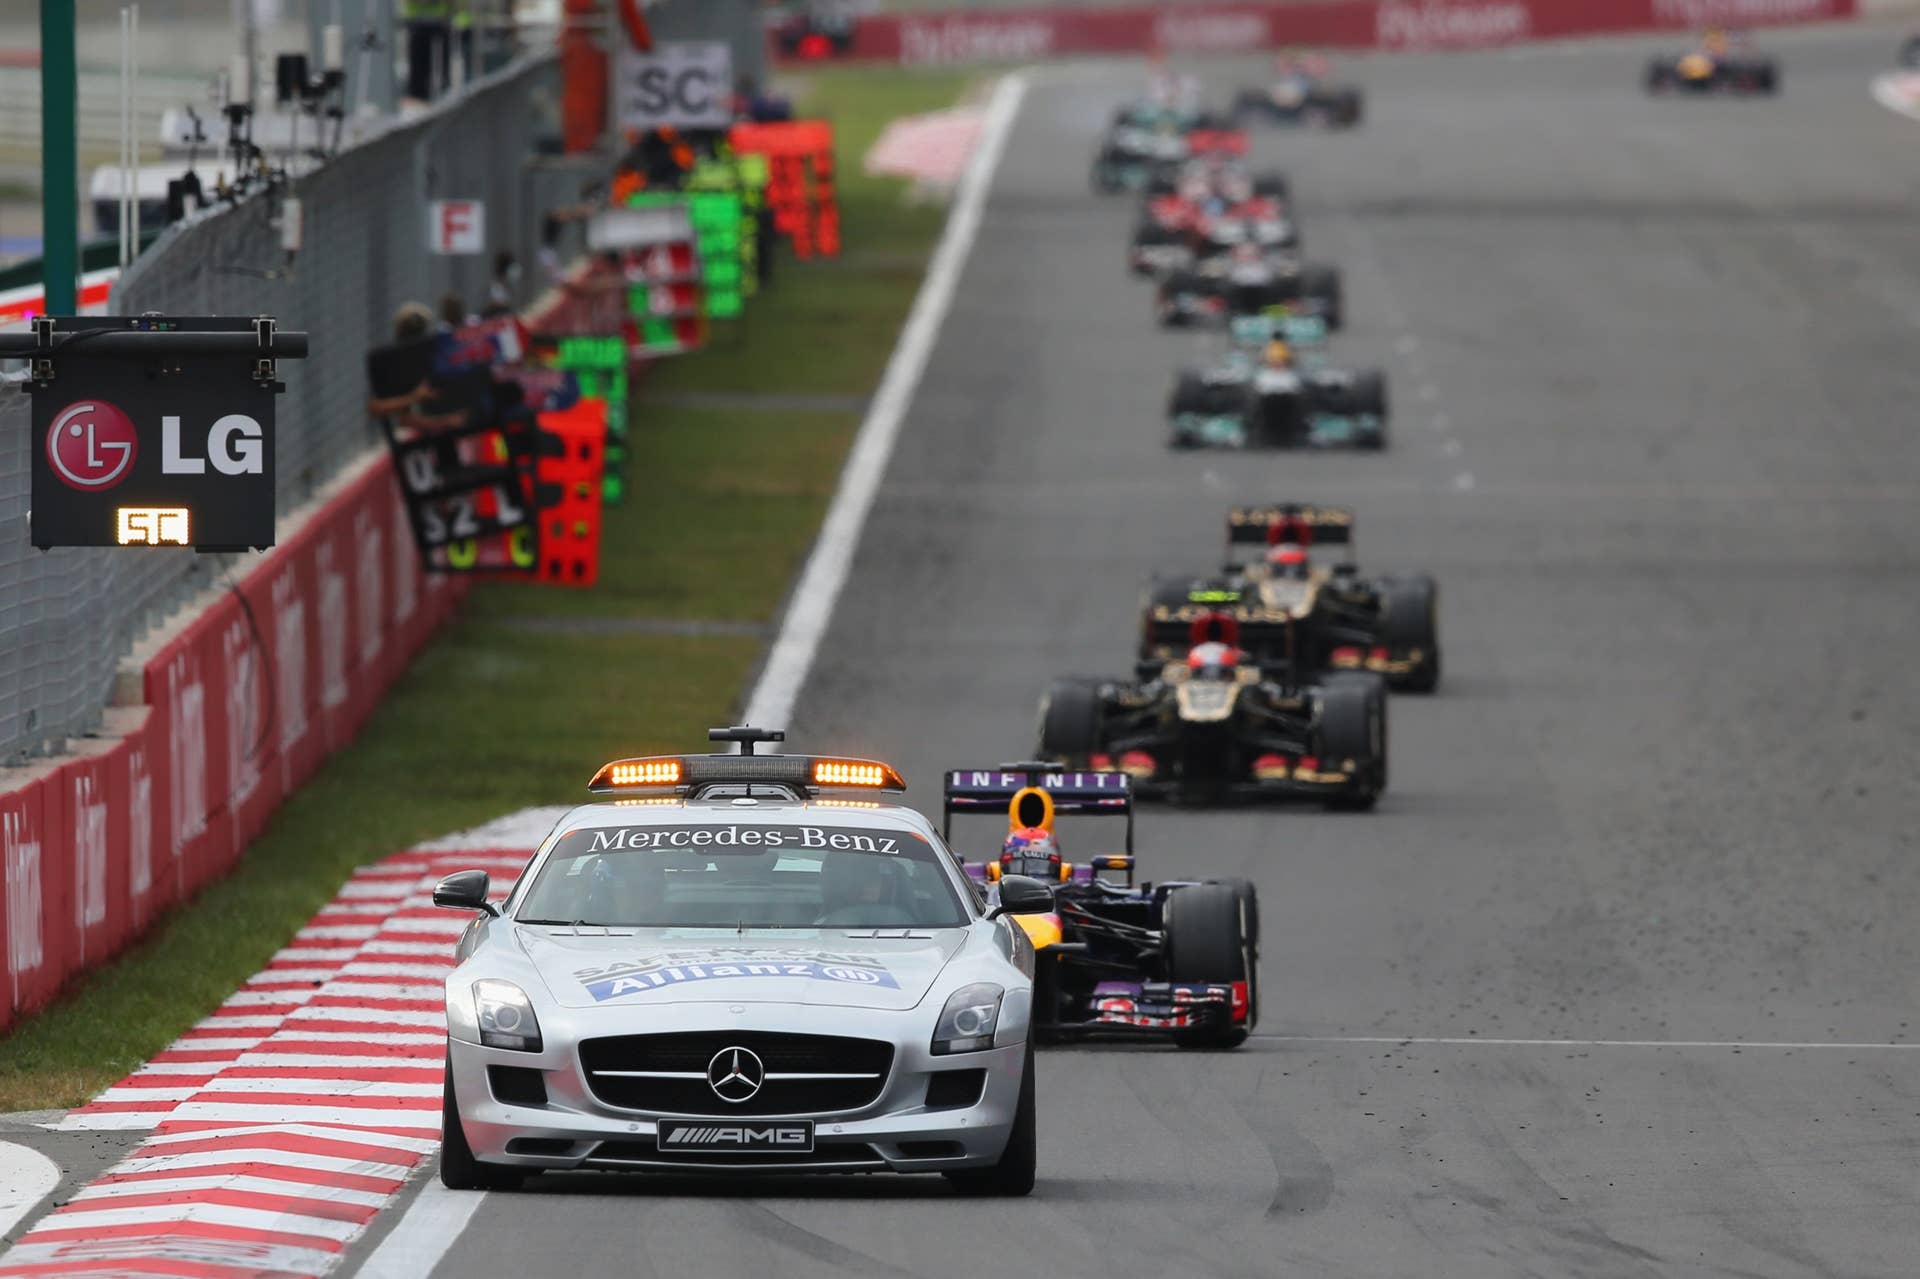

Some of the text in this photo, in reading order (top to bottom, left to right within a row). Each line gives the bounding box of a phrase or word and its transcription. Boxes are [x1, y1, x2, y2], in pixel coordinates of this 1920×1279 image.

[635, 67, 709, 115] SC
[441, 203, 473, 250] F
[161, 413, 264, 476] LG
[117, 507, 189, 545] SC
[952, 771, 1127, 788] INFNITI
[587, 826, 900, 854] Mercedes-Benz
[610, 962, 815, 995] Allianz
[710, 1127, 806, 1144] AMG
